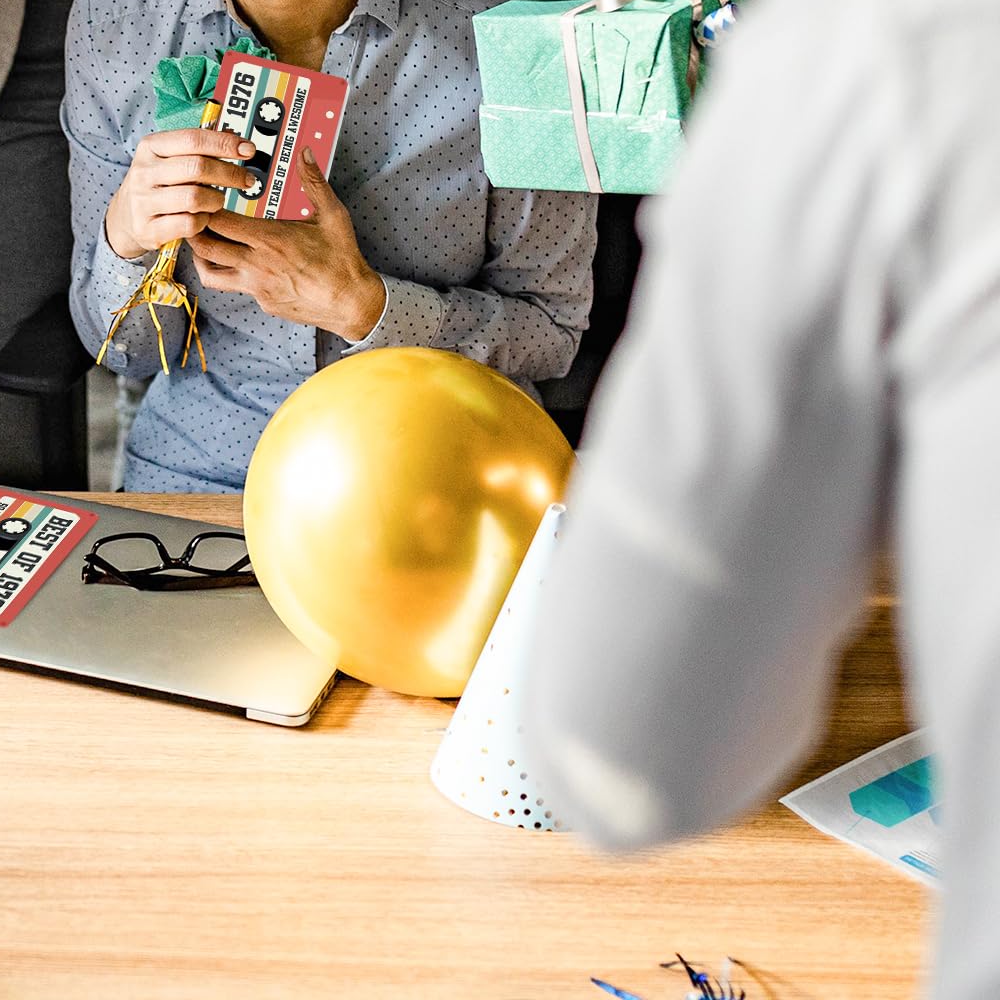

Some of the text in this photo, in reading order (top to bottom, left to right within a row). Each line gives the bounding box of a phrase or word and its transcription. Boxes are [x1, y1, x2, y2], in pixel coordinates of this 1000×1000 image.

[227, 71, 256, 119] 1976
[292, 87, 307, 134] AWESOME
[279, 135, 296, 164] BEING
[275, 165, 288, 179] OF
[268, 179, 284, 209] YEARS
[29, 515, 73, 552] BEST
[12, 551, 42, 573] OF
